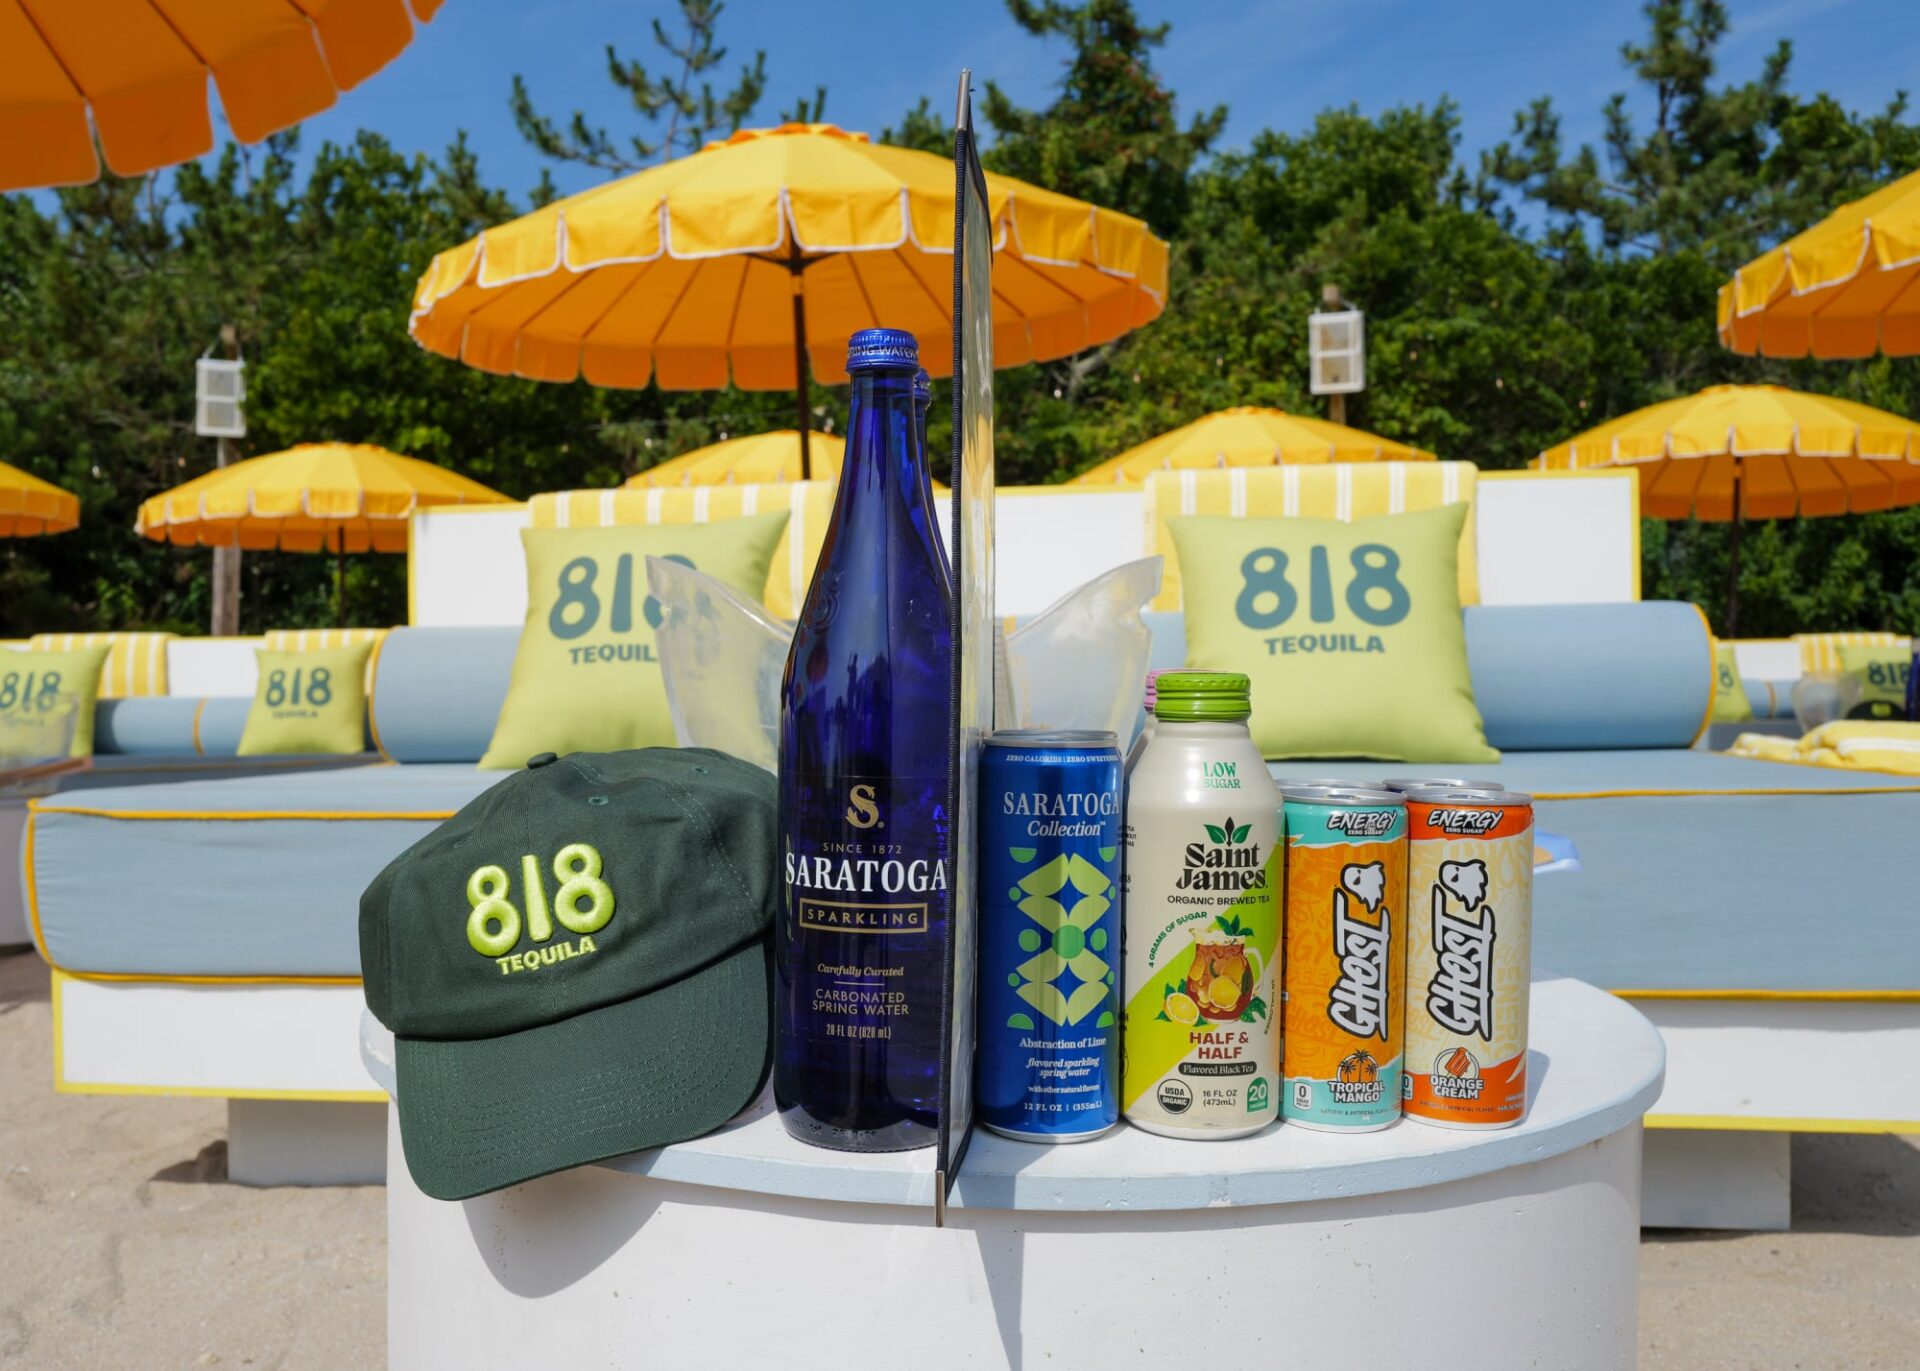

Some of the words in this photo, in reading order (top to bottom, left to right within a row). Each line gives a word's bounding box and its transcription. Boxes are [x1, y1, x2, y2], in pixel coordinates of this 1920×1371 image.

[1235, 543, 1411, 630] 818
[1264, 634, 1386, 655] TEQUILA
[569, 644, 658, 665] TEQUIL
[266, 667, 332, 708] 818
[1203, 762, 1236, 777] LOW
[1204, 779, 1241, 789] SUGAR
[1003, 791, 1120, 816] SARATOGA
[1328, 811, 1397, 830] ENERGY
[1428, 810, 1502, 829] ENERGY
[823, 842, 862, 854] SINCE
[872, 845, 902, 855] 1872
[1185, 842, 1260, 868] Saint
[786, 852, 948, 893] SARATOGA
[1176, 868, 1268, 891] James
[466, 843, 616, 957] 818
[1167, 895, 1215, 905] ORGANIC
[1217, 895, 1256, 906] BREWED
[1258, 895, 1270, 904] TEA
[807, 908, 918, 925] SPARKLING
[1149, 931, 1166, 960] GRAMS
[1165, 921, 1176, 933] OF
[1176, 911, 1207, 925] SUGAR
[496, 936, 596, 975] TEQUILA
[1427, 885, 1496, 1041] GHOST
[817, 963, 861, 977] Carefully
[863, 966, 904, 976] Curated
[1328, 888, 1391, 1041] GHOST
[815, 988, 905, 1003] CARBONATED
[812, 1000, 858, 1015] SPRING
[864, 1004, 909, 1016] WATER
[826, 1023, 835, 1036] 28
[837, 1024, 845, 1037] FL
[847, 1025, 857, 1038] OZ
[877, 1026, 891, 1040] mL)
[1190, 1032, 1234, 1045] HALF
[1238, 1031, 1249, 1044] &
[1019, 1038, 1076, 1049] Abstraction
[1077, 1038, 1088, 1048] of
[1088, 1037, 1107, 1047] Lime
[1198, 1046, 1242, 1060] HALF
[1026, 1057, 1063, 1068] flavored
[1064, 1056, 1100, 1069] sparkling
[1183, 1064, 1218, 1075] Flavored
[1219, 1064, 1241, 1075] Black
[1242, 1063, 1254, 1073] Tea
[1039, 1067, 1067, 1079] spring
[1067, 1068, 1091, 1076] water
[1329, 1081, 1385, 1093] TROPICAL
[1430, 1075, 1484, 1089] ORANGE
[1164, 1087, 1185, 1096] USDA
[1226, 1089, 1237, 1097] OZ
[1249, 1083, 1267, 1101] 20
[1299, 1085, 1307, 1097] 0
[1335, 1092, 1380, 1103] MANGO
[1433, 1086, 1479, 1099] CREAM
[1024, 1102, 1034, 1110] 12
[1036, 1103, 1047, 1111] FL
[1049, 1104, 1062, 1112] OZ
[1072, 1101, 1102, 1111] (355mL)
[1162, 1097, 1187, 1106] ORGANIC
[1203, 1098, 1236, 1107] (473mL)
